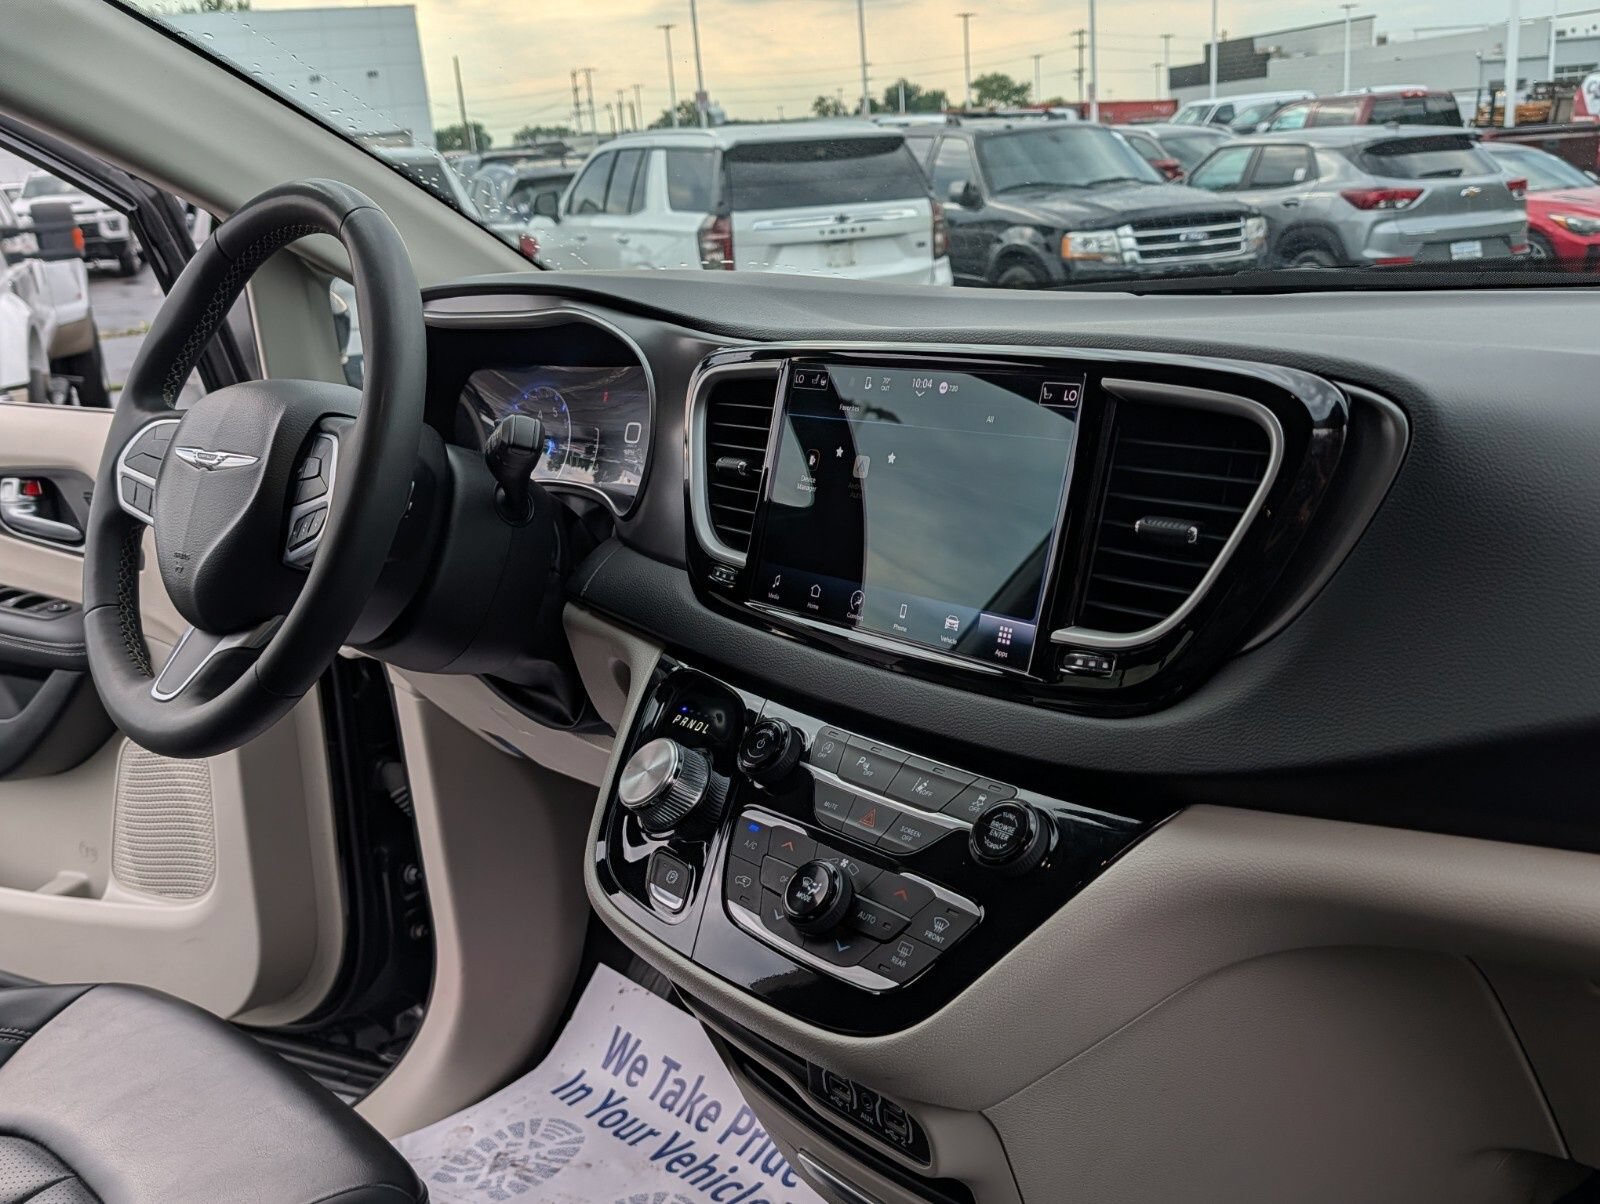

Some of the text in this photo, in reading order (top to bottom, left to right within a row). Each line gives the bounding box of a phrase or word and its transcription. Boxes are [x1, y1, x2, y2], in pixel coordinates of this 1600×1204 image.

[912, 378, 933, 389] 10:04
[1063, 390, 1078, 401] LO
[892, 623, 908, 633] Phone
[994, 648, 1008, 659] Apps
[823, 801, 839, 810] MUTE
[900, 825, 922, 838] SCREEN
[989, 829, 1010, 841] ENTER
[901, 834, 913, 842] OFF
[743, 840, 758, 850] A/C
[857, 911, 877, 924] AUTO
[924, 929, 945, 944] FRONT
[891, 955, 907, 967] REAR
[601, 1024, 648, 1088] We
[648, 1054, 722, 1133] Take
[860, 1112, 874, 1125] AUX
[550, 1068, 771, 1204] In Your Vehicl
